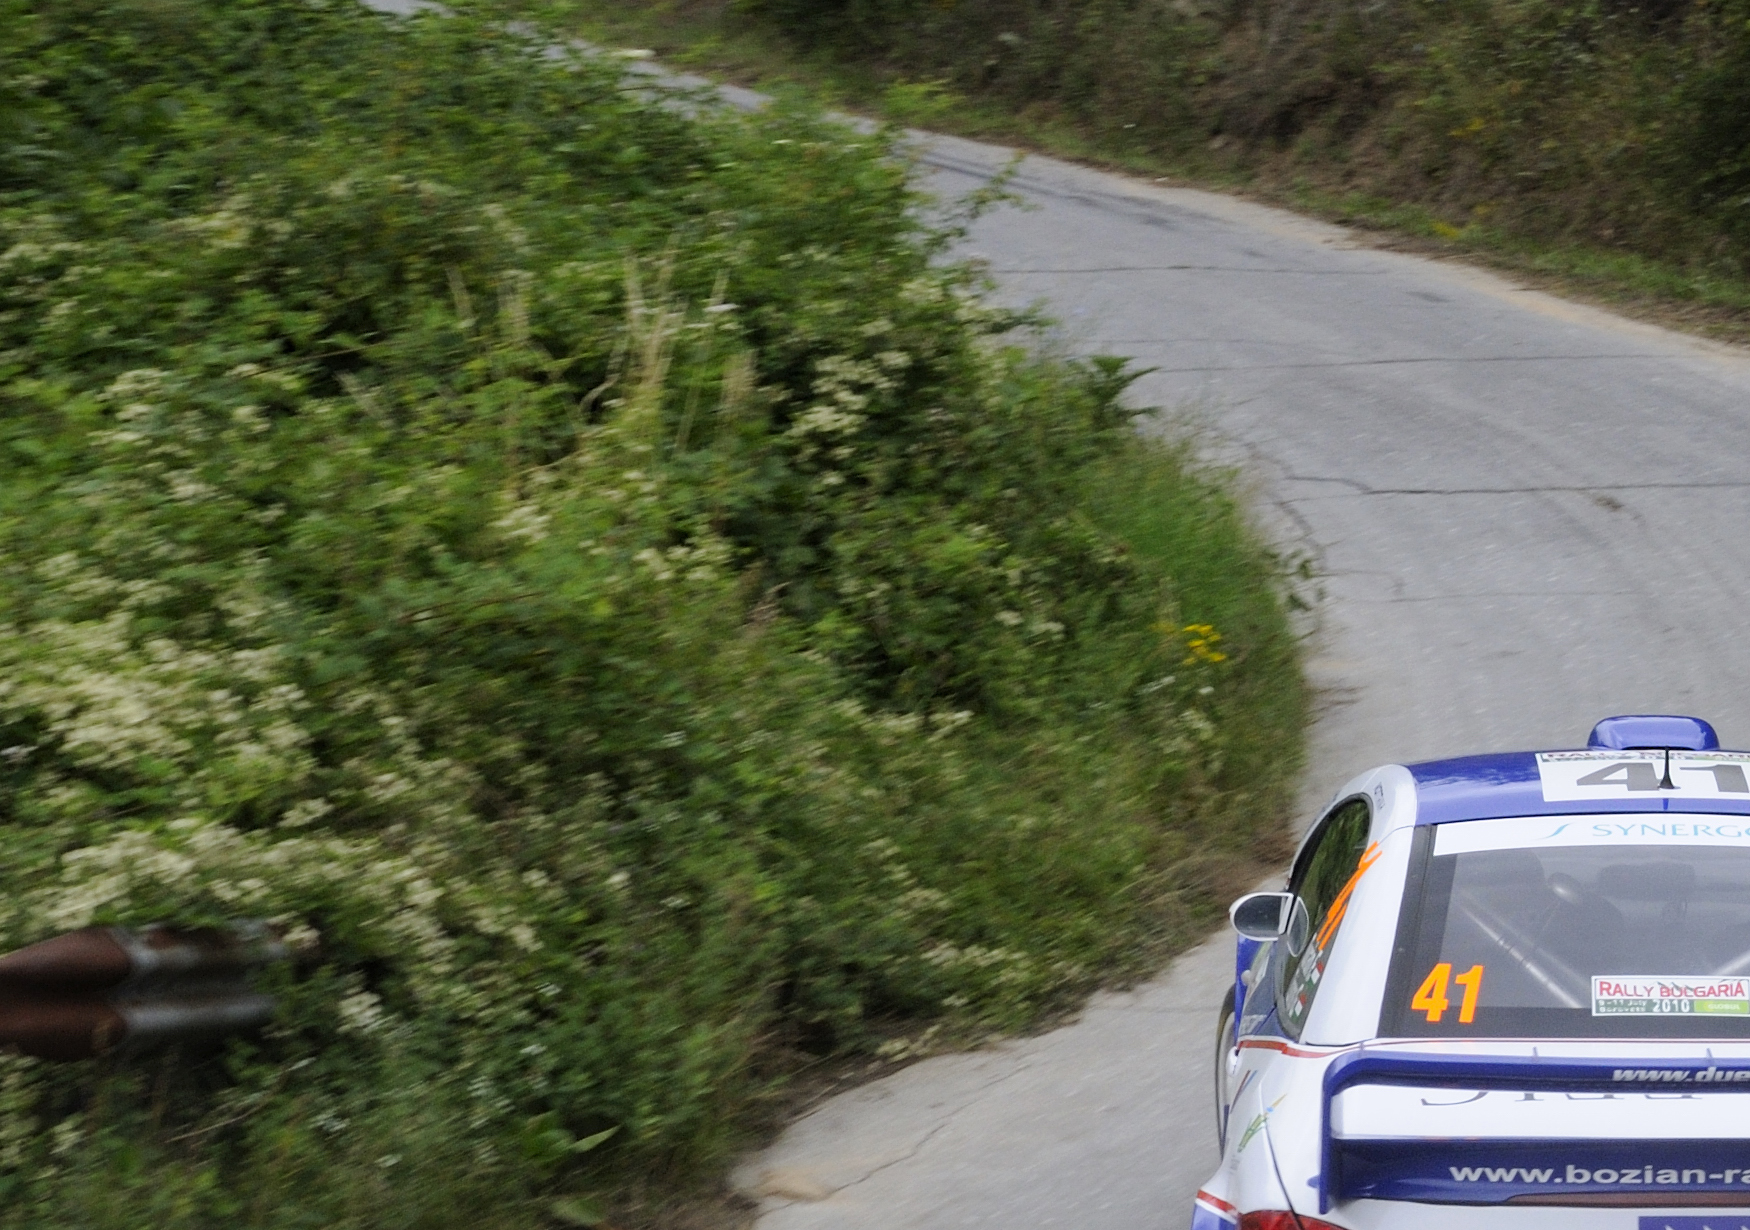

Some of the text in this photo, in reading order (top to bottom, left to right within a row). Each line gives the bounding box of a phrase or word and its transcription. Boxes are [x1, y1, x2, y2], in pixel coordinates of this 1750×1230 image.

[1577, 762, 1750, 793] 41
[1411, 963, 1484, 1023] 41
[1599, 981, 1745, 998] RALLY BULGARIA
[1652, 999, 1690, 1013] 2010
